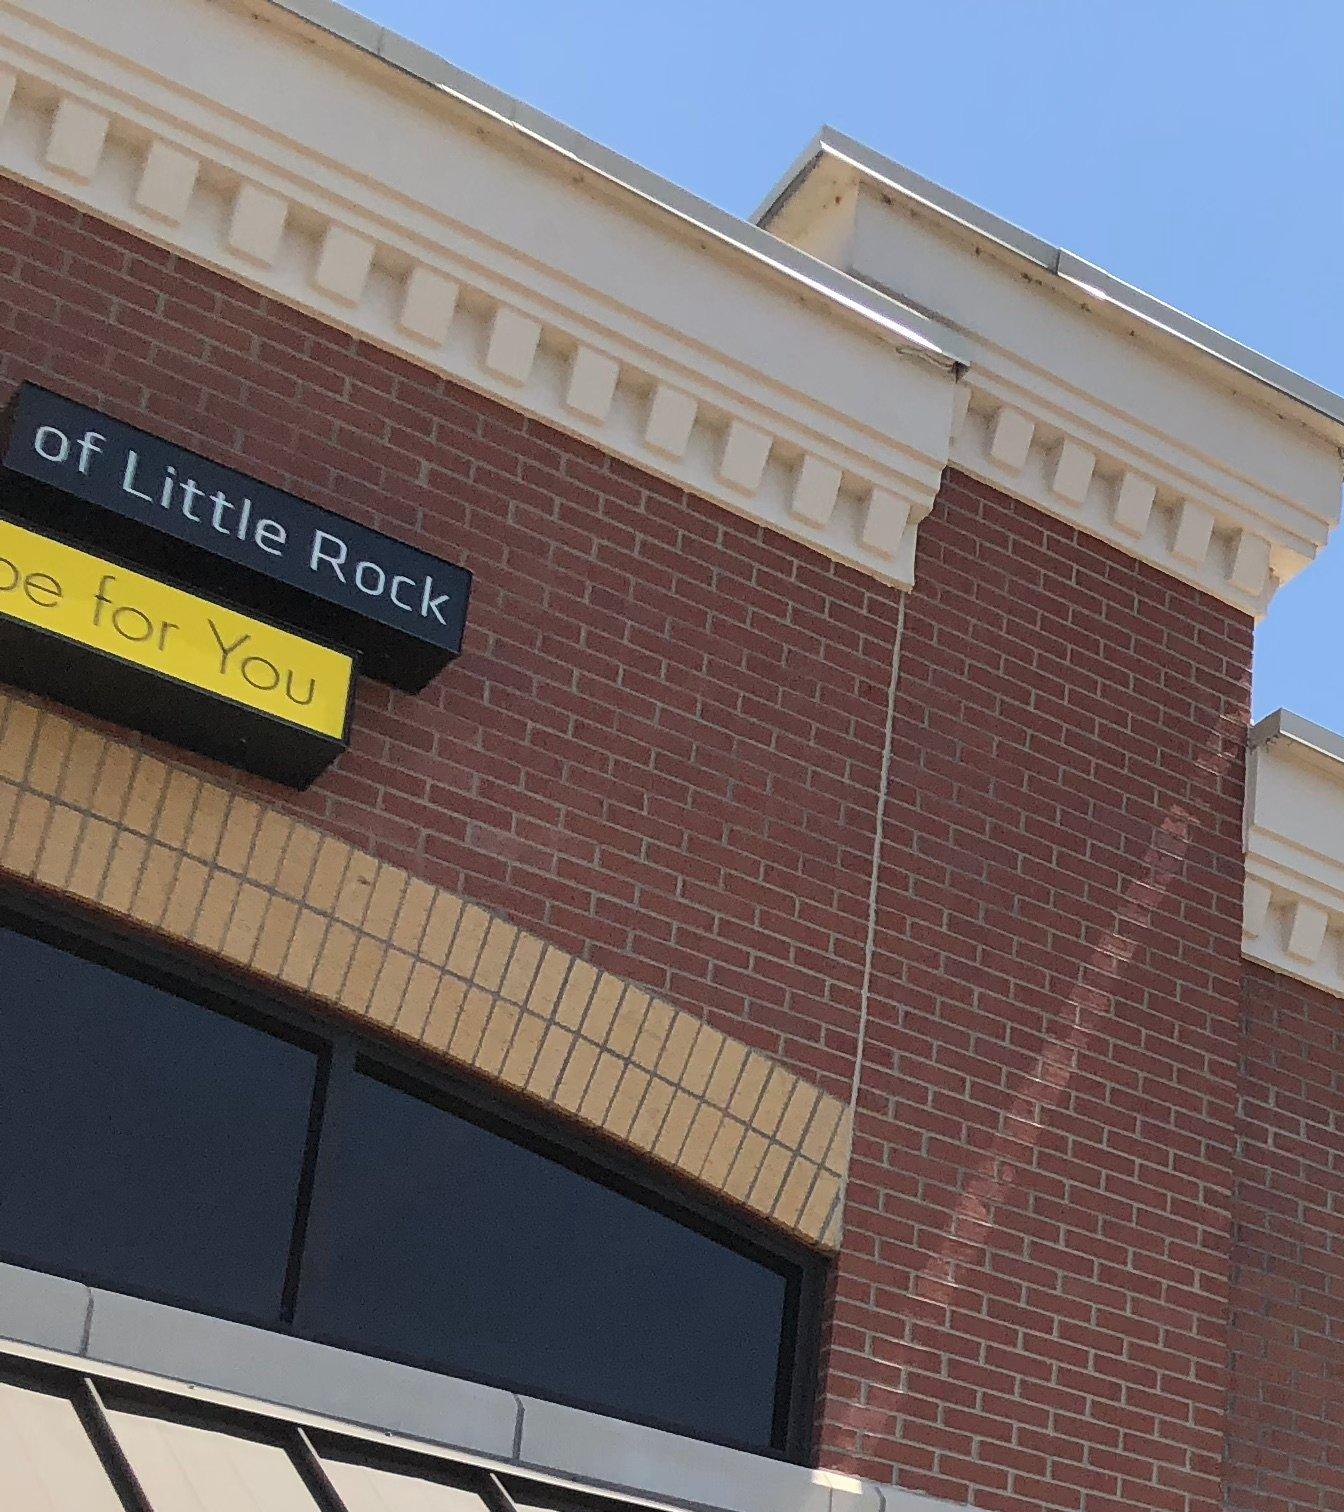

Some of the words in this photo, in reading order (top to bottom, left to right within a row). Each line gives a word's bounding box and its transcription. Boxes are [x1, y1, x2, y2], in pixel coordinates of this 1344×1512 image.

[34, 425, 107, 475] of
[122, 448, 287, 557] Little
[308, 528, 452, 626] Rock
[94, 574, 180, 653] for
[207, 618, 316, 707] You
